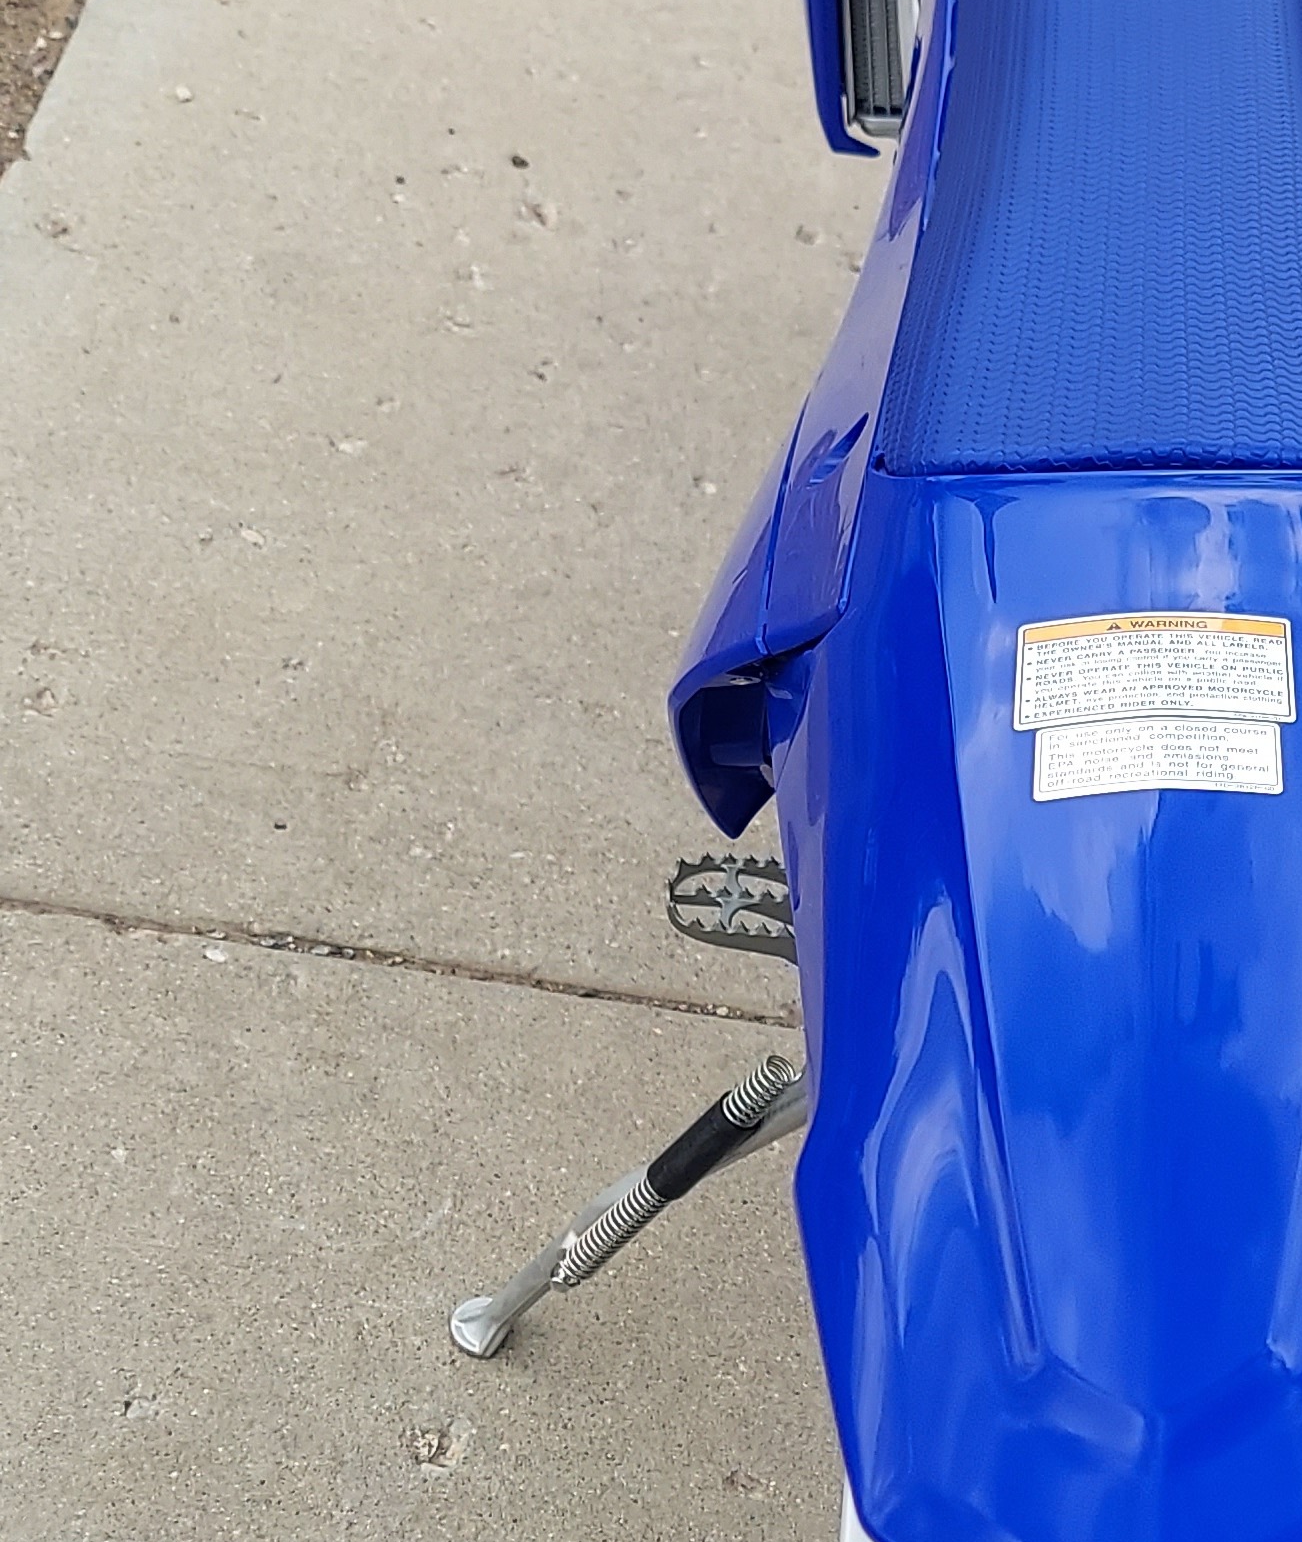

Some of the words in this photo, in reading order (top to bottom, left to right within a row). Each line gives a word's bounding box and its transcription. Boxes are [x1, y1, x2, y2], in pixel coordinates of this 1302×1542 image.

[1037, 640, 1080, 650] BEFORE
[1063, 643, 1112, 653] OWNER'S
[1037, 655, 1071, 665] NEVER
[1036, 671, 1072, 680] NEVER
[1079, 665, 1129, 675] OPERATE
[1243, 667, 1283, 675] PUBLIC
[1035, 692, 1077, 702] ALWAYS
[1084, 688, 1116, 696] WEAR
[1208, 686, 1283, 697] MOTORCYCLE
[1034, 704, 1114, 718] EXPERIENCED
[1050, 752, 1074, 761] This
[1083, 745, 1154, 756] motorcycle
[1221, 764, 1268, 772] general
